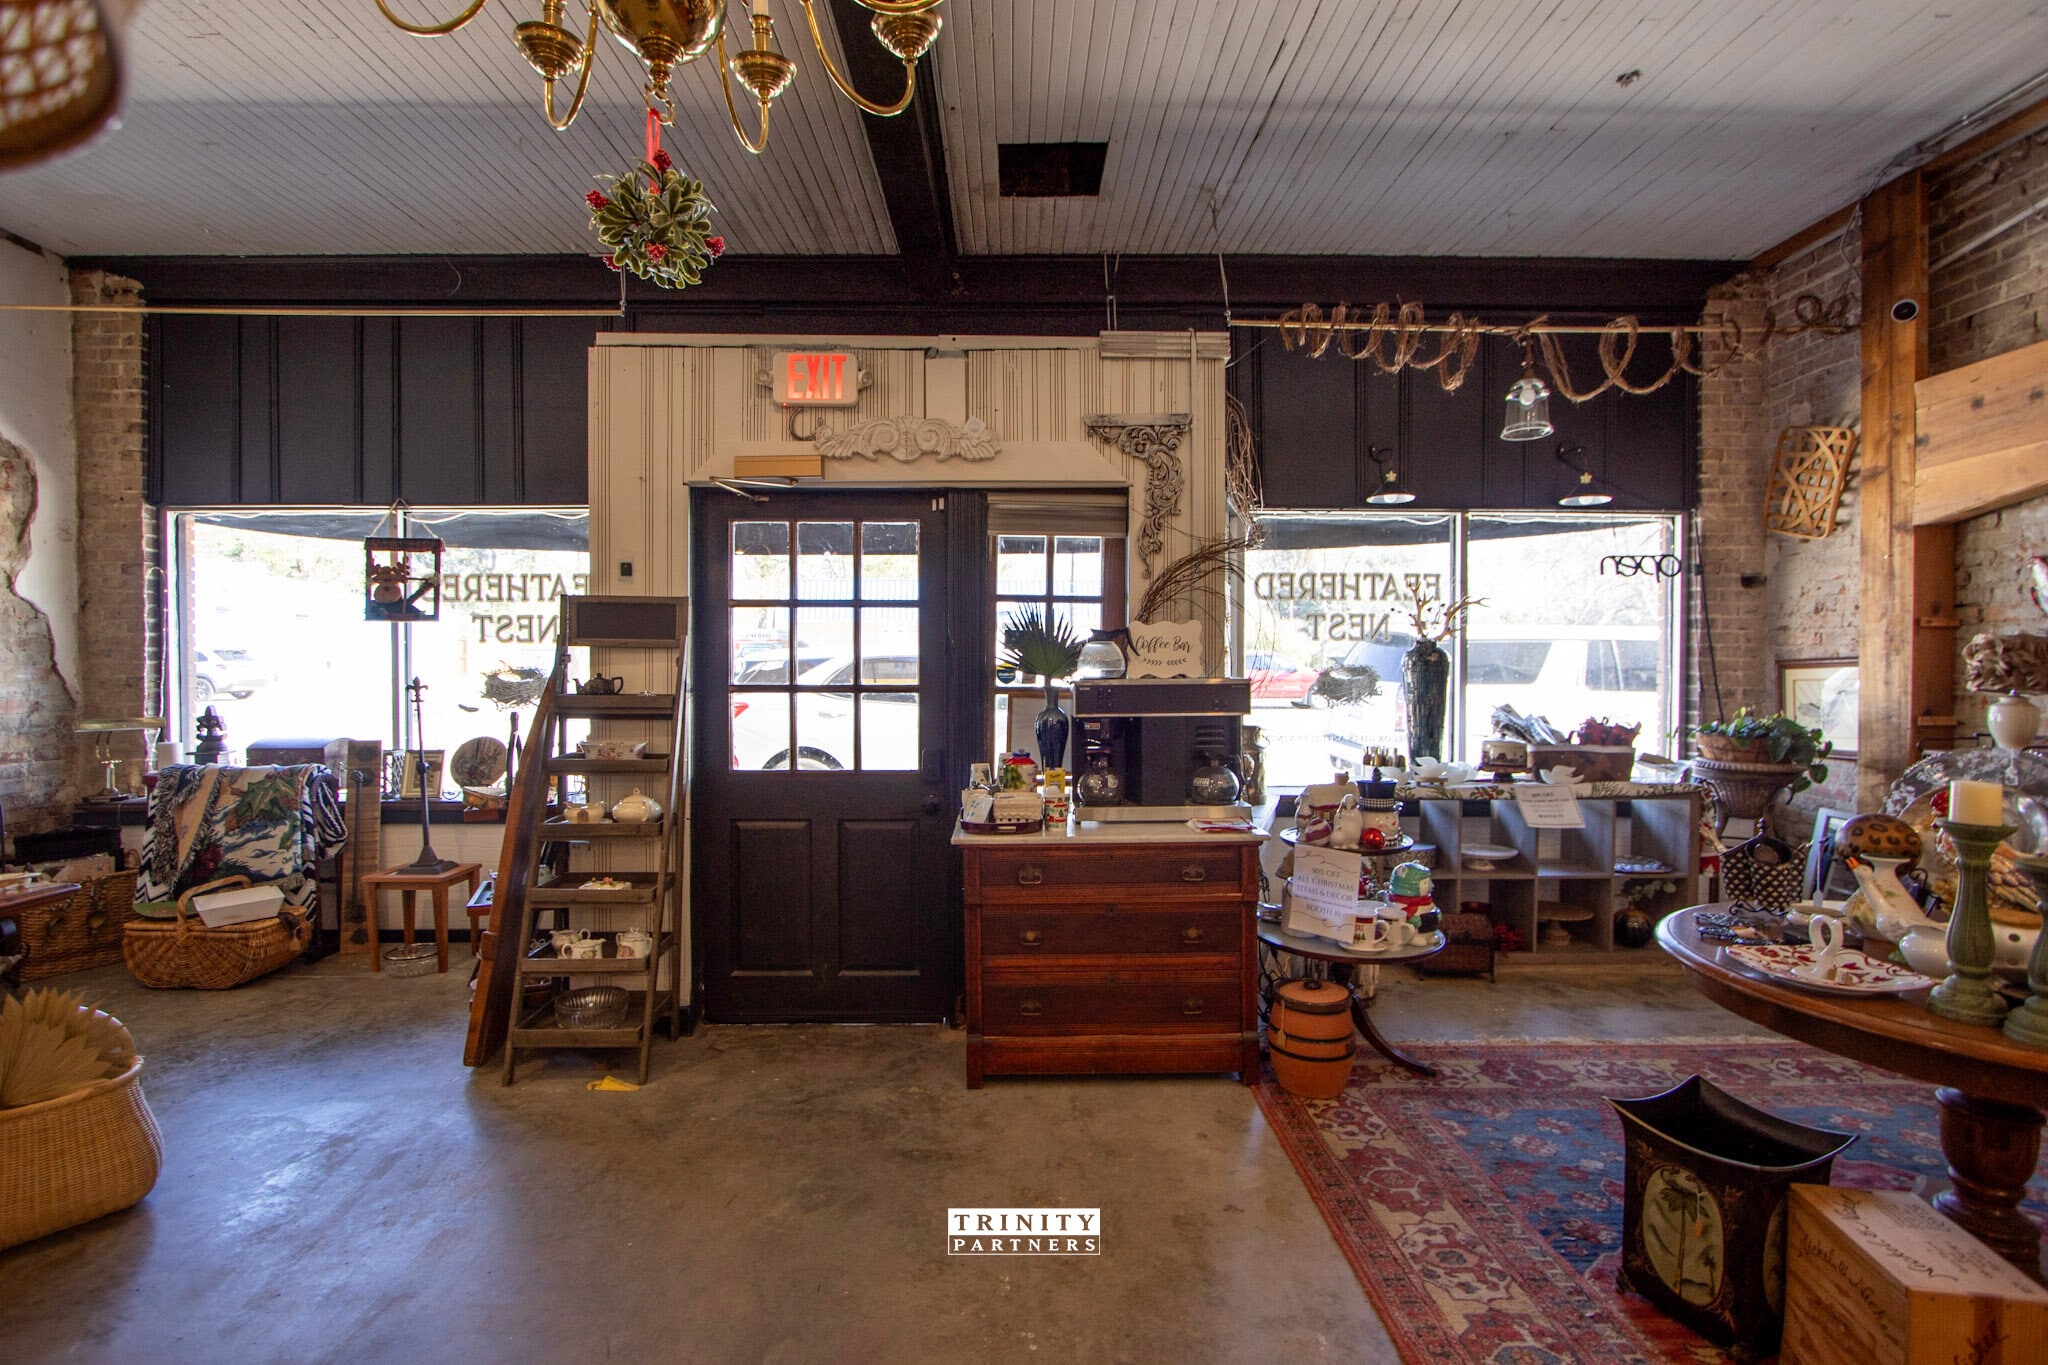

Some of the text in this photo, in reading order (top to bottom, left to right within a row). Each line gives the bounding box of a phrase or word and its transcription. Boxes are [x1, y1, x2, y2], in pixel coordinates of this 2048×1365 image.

[787, 353, 847, 400] EXIT
[1136, 635, 1194, 653] Coffee Bar
[1326, 870, 1340, 878] OFF
[1312, 877, 1354, 891] CHRISTMAS
[1297, 885, 1318, 895] ITEMS
[1326, 891, 1353, 902] DECOR
[1306, 903, 1332, 914] BOOTH
